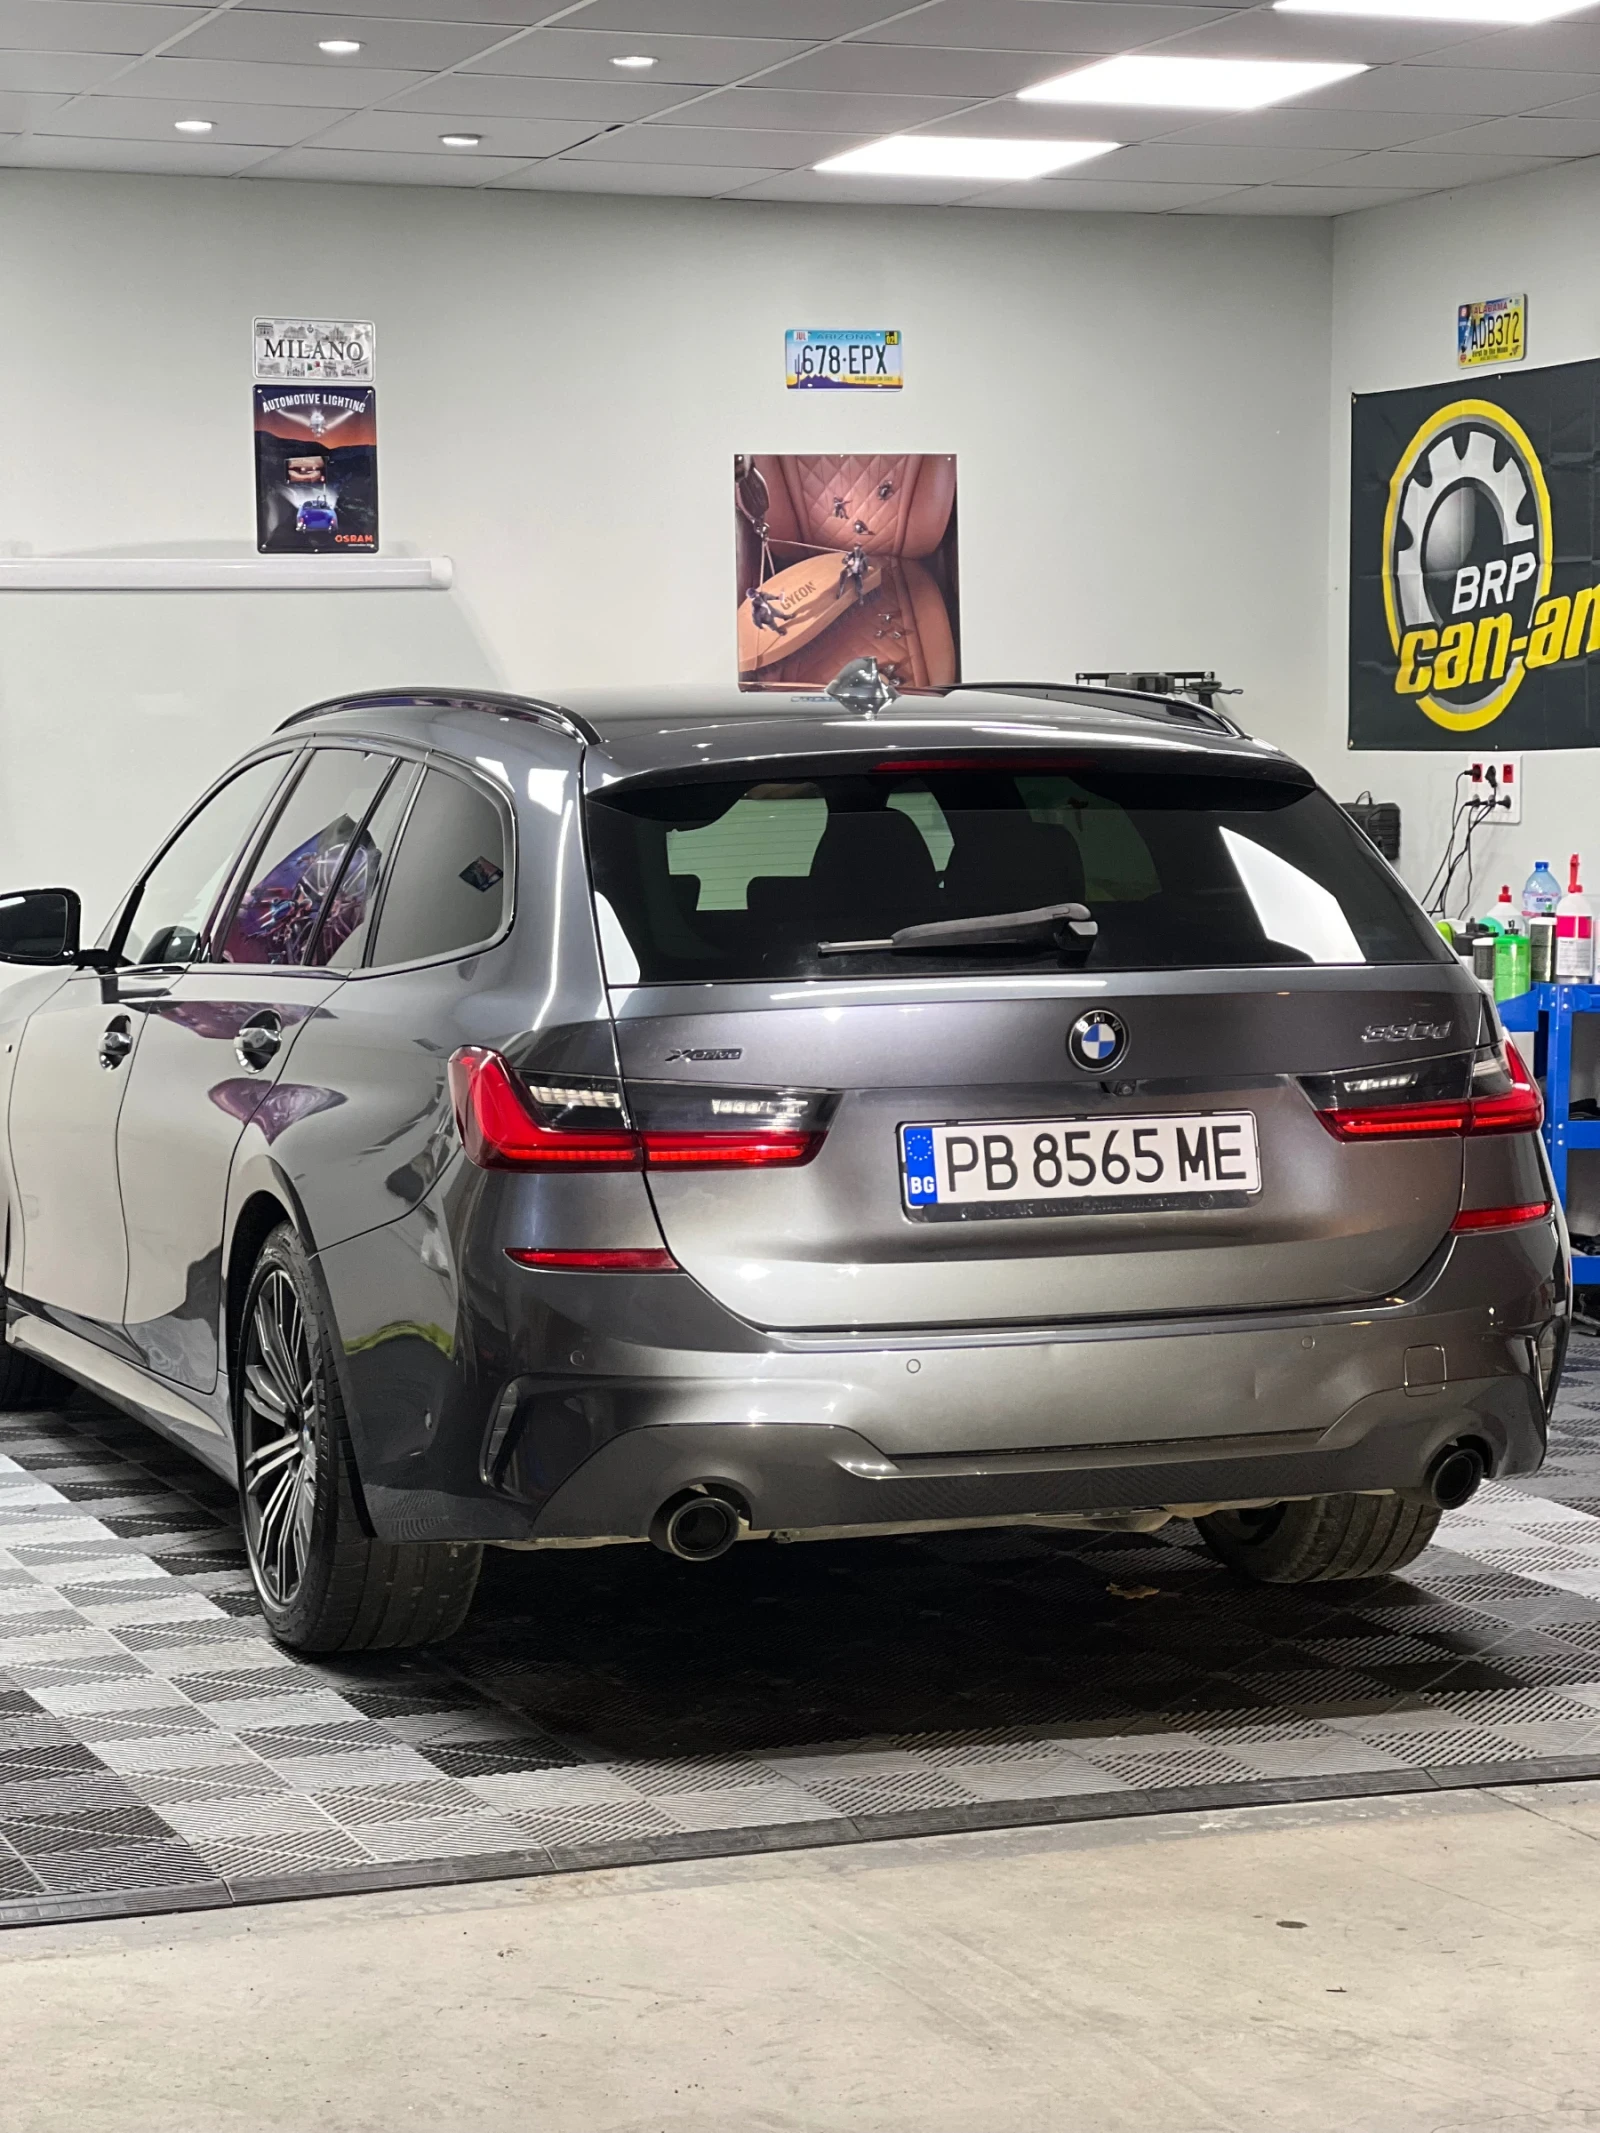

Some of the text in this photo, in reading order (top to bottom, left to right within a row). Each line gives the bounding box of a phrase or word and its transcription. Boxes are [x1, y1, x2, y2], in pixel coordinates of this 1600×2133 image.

[1474, 301, 1508, 315] ALABAMA
[816, 332, 872, 340] ARIZONA
[1471, 311, 1520, 350] ADB372
[264, 338, 364, 361] MILANO
[262, 394, 366, 413] AUTOMOTIVE LIGHTING
[334, 534, 373, 543] OSRAM
[1452, 551, 1536, 615] BRP
[780, 580, 817, 610] GYEON
[945, 1125, 1247, 1192] PB 8565 ME
[910, 1176, 935, 1195] BG
